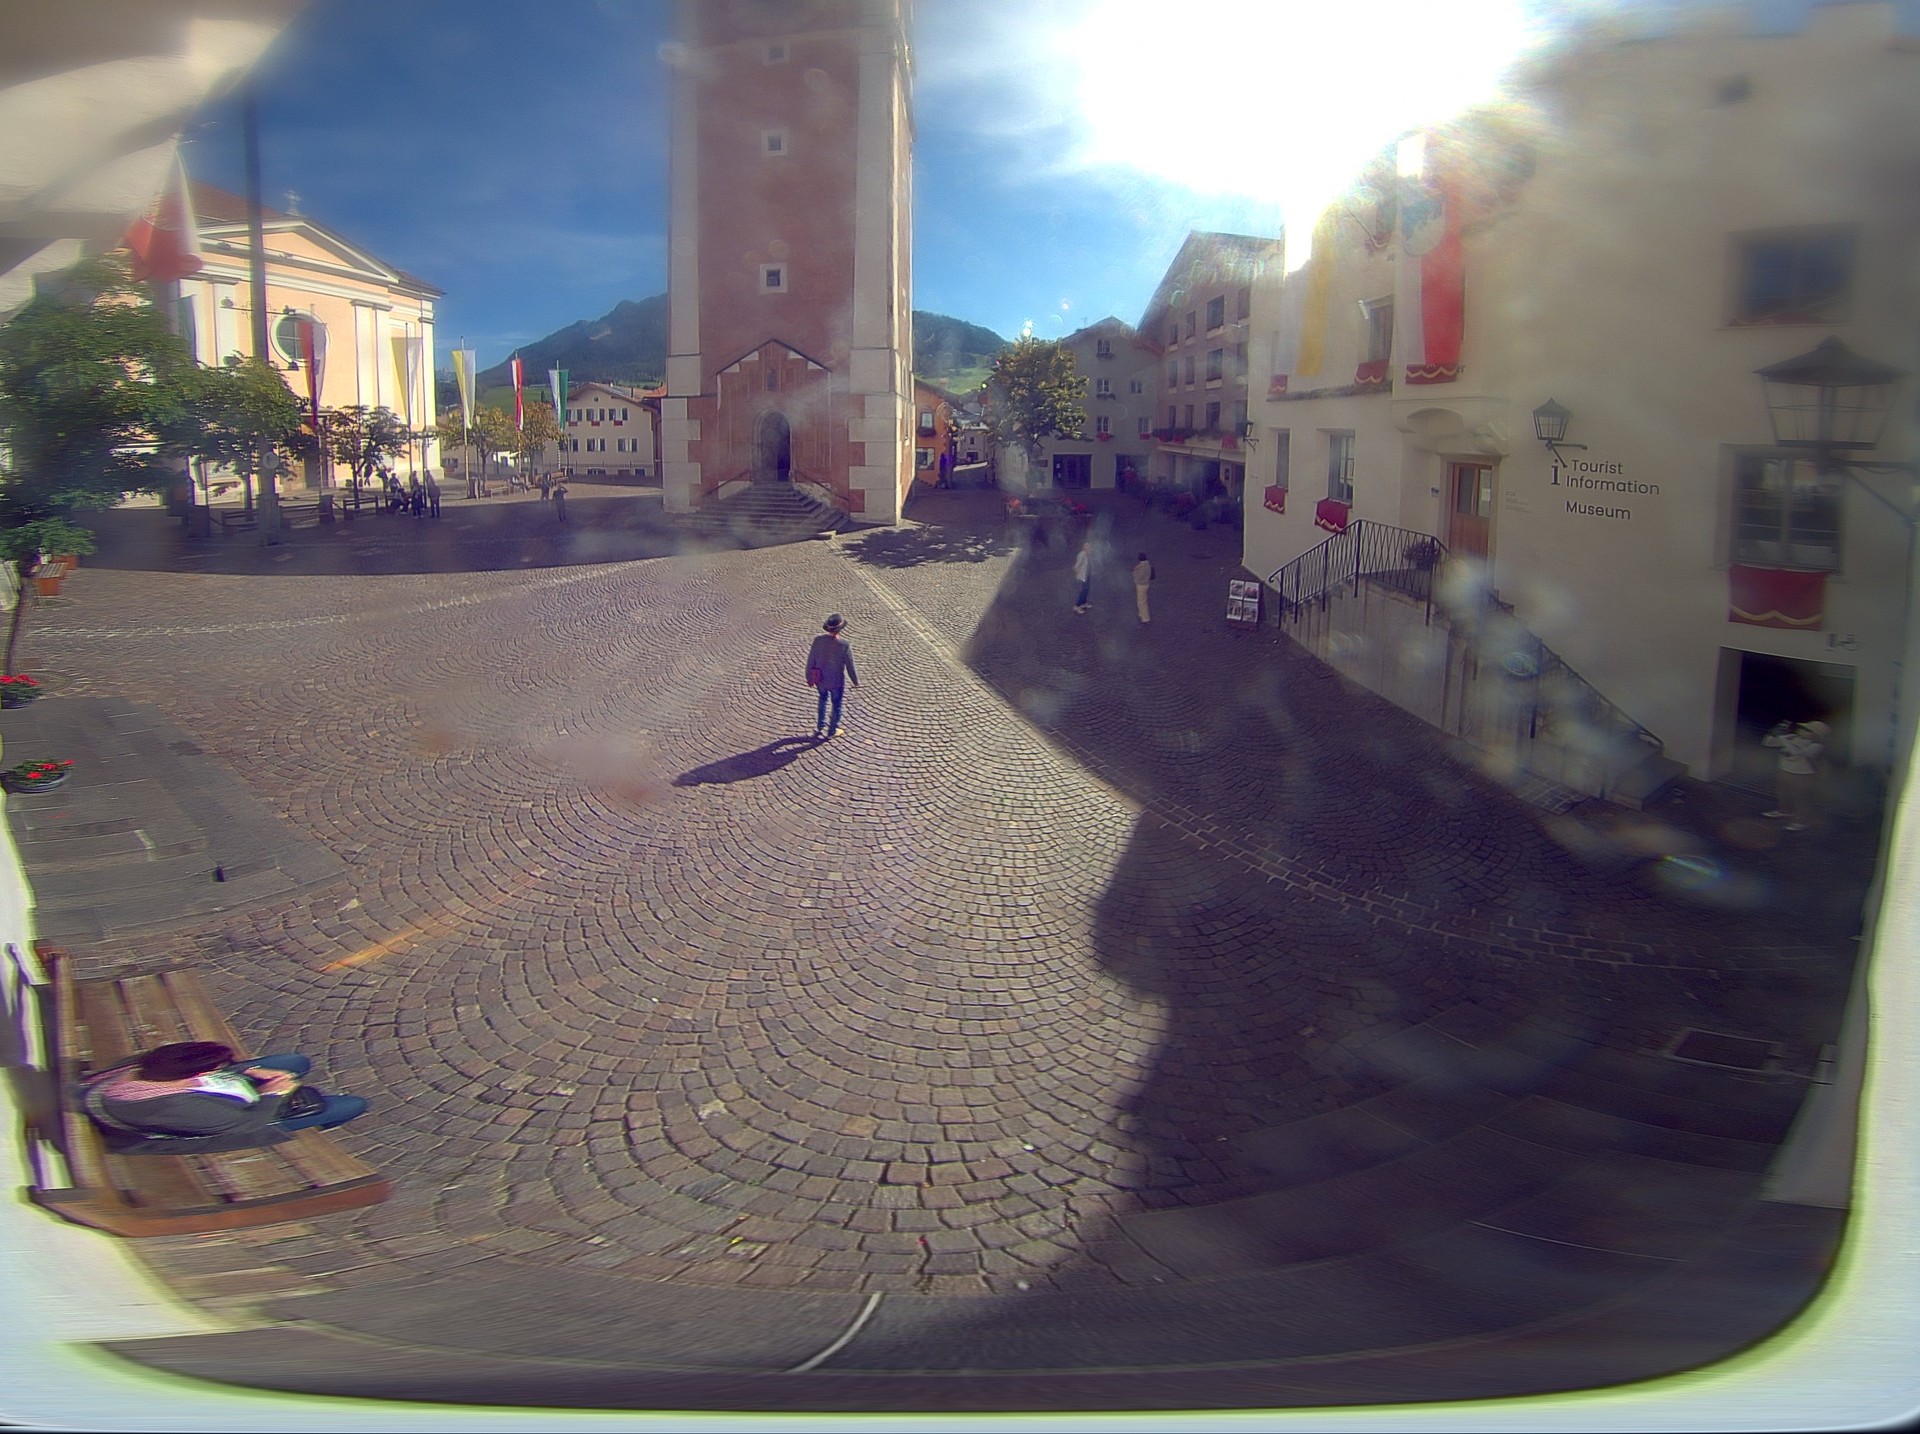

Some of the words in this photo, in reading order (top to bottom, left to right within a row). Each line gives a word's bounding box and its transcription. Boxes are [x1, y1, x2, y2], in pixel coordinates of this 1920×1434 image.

[1551, 458, 1560, 486] i
[1572, 460, 1624, 475] Tourist
[1566, 475, 1660, 495] Information
[1566, 501, 1631, 520] Museum
